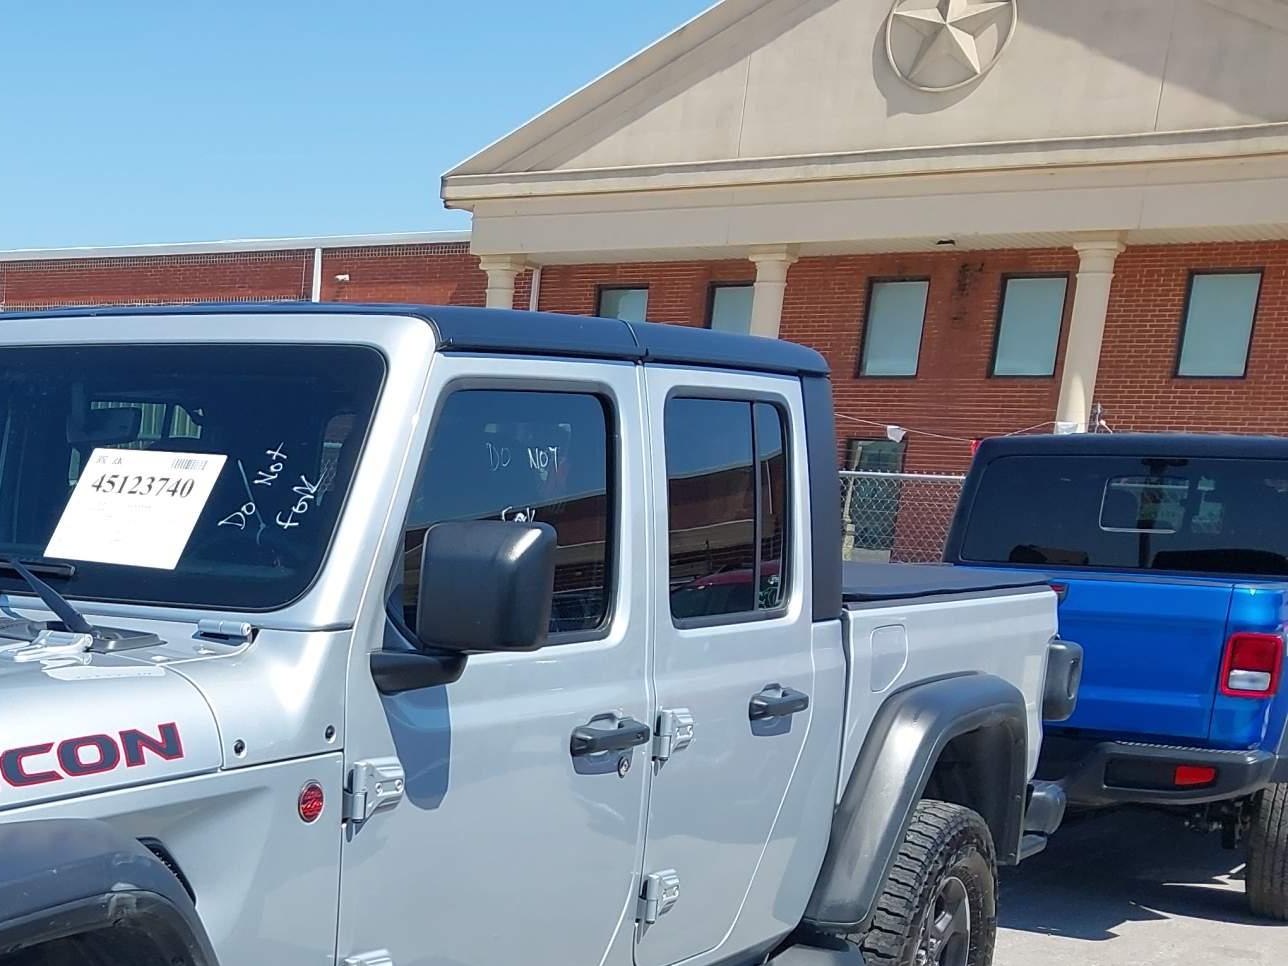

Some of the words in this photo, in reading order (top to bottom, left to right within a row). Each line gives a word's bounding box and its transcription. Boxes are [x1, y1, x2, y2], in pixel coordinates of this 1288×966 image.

[527, 446, 560, 473] NOT
[91, 473, 196, 499] 45123740
[217, 501, 256, 530] Do
